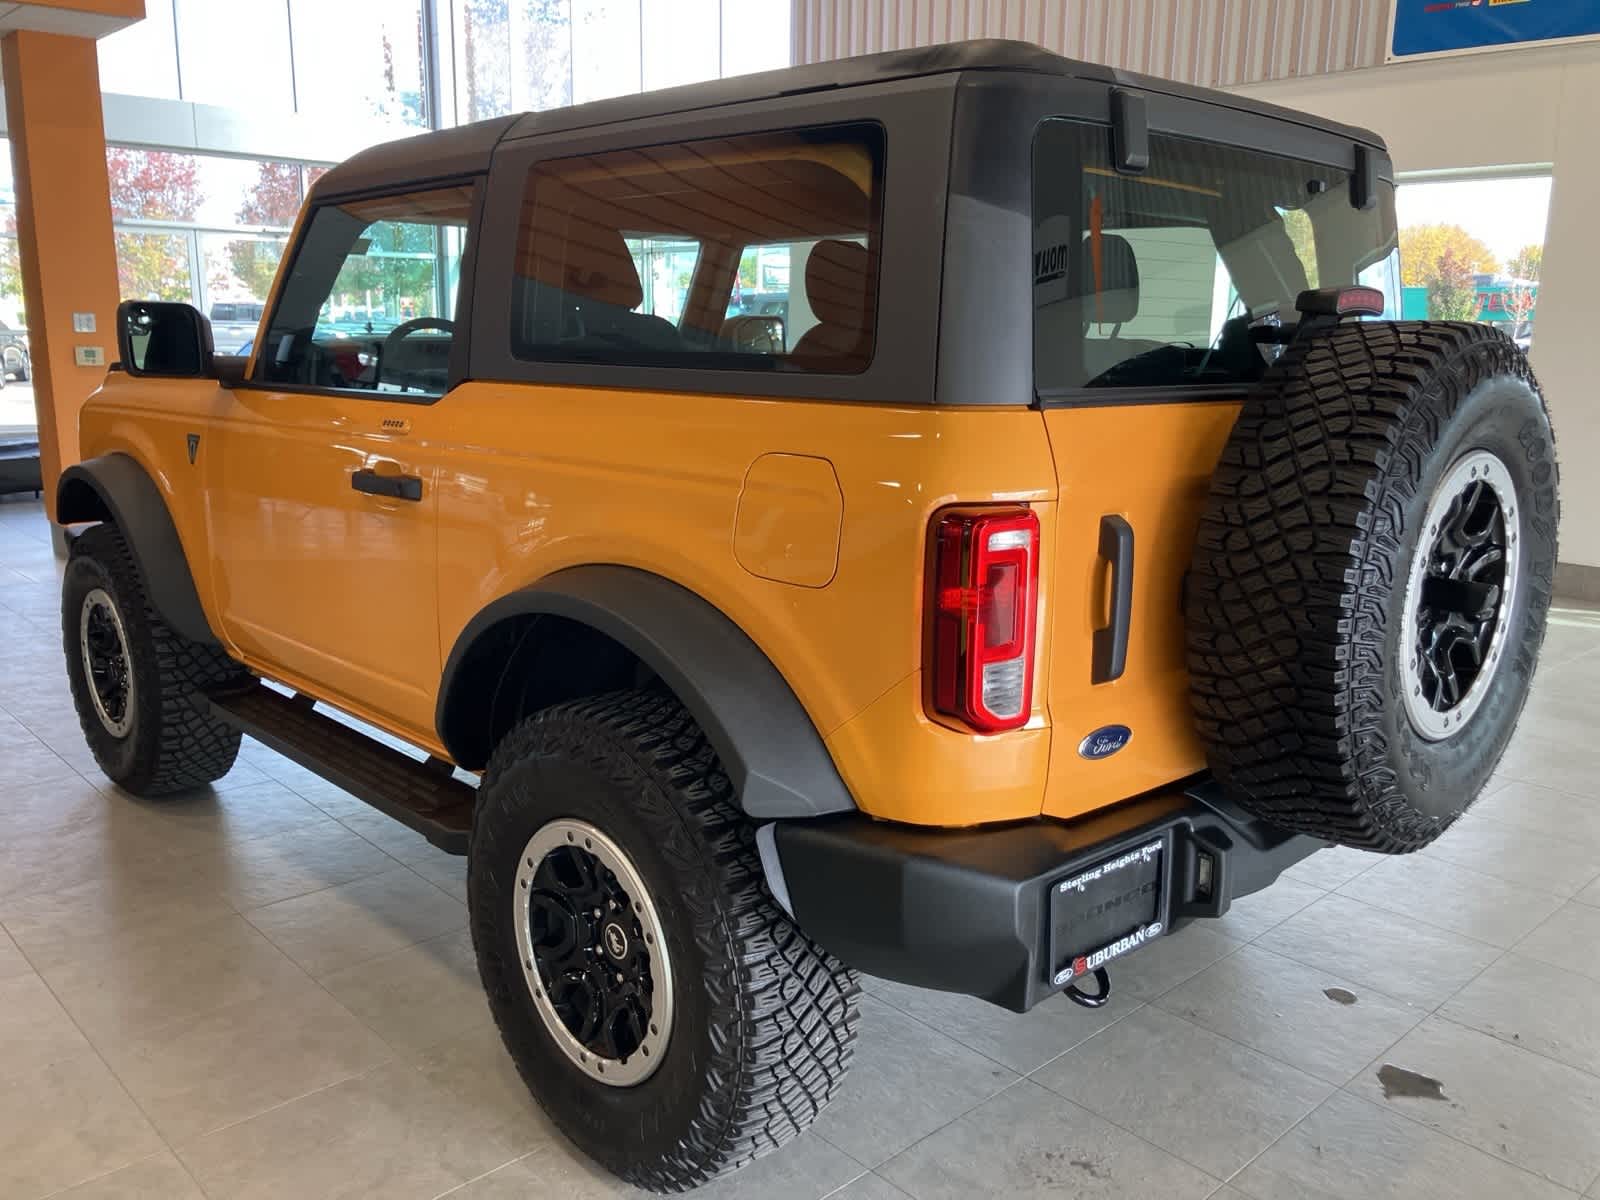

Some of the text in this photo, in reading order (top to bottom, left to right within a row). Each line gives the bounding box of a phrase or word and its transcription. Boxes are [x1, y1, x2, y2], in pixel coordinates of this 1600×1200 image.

[1059, 840, 1162, 893] Sterling Heights Ford
[1072, 928, 1146, 976] SUBURBAN
